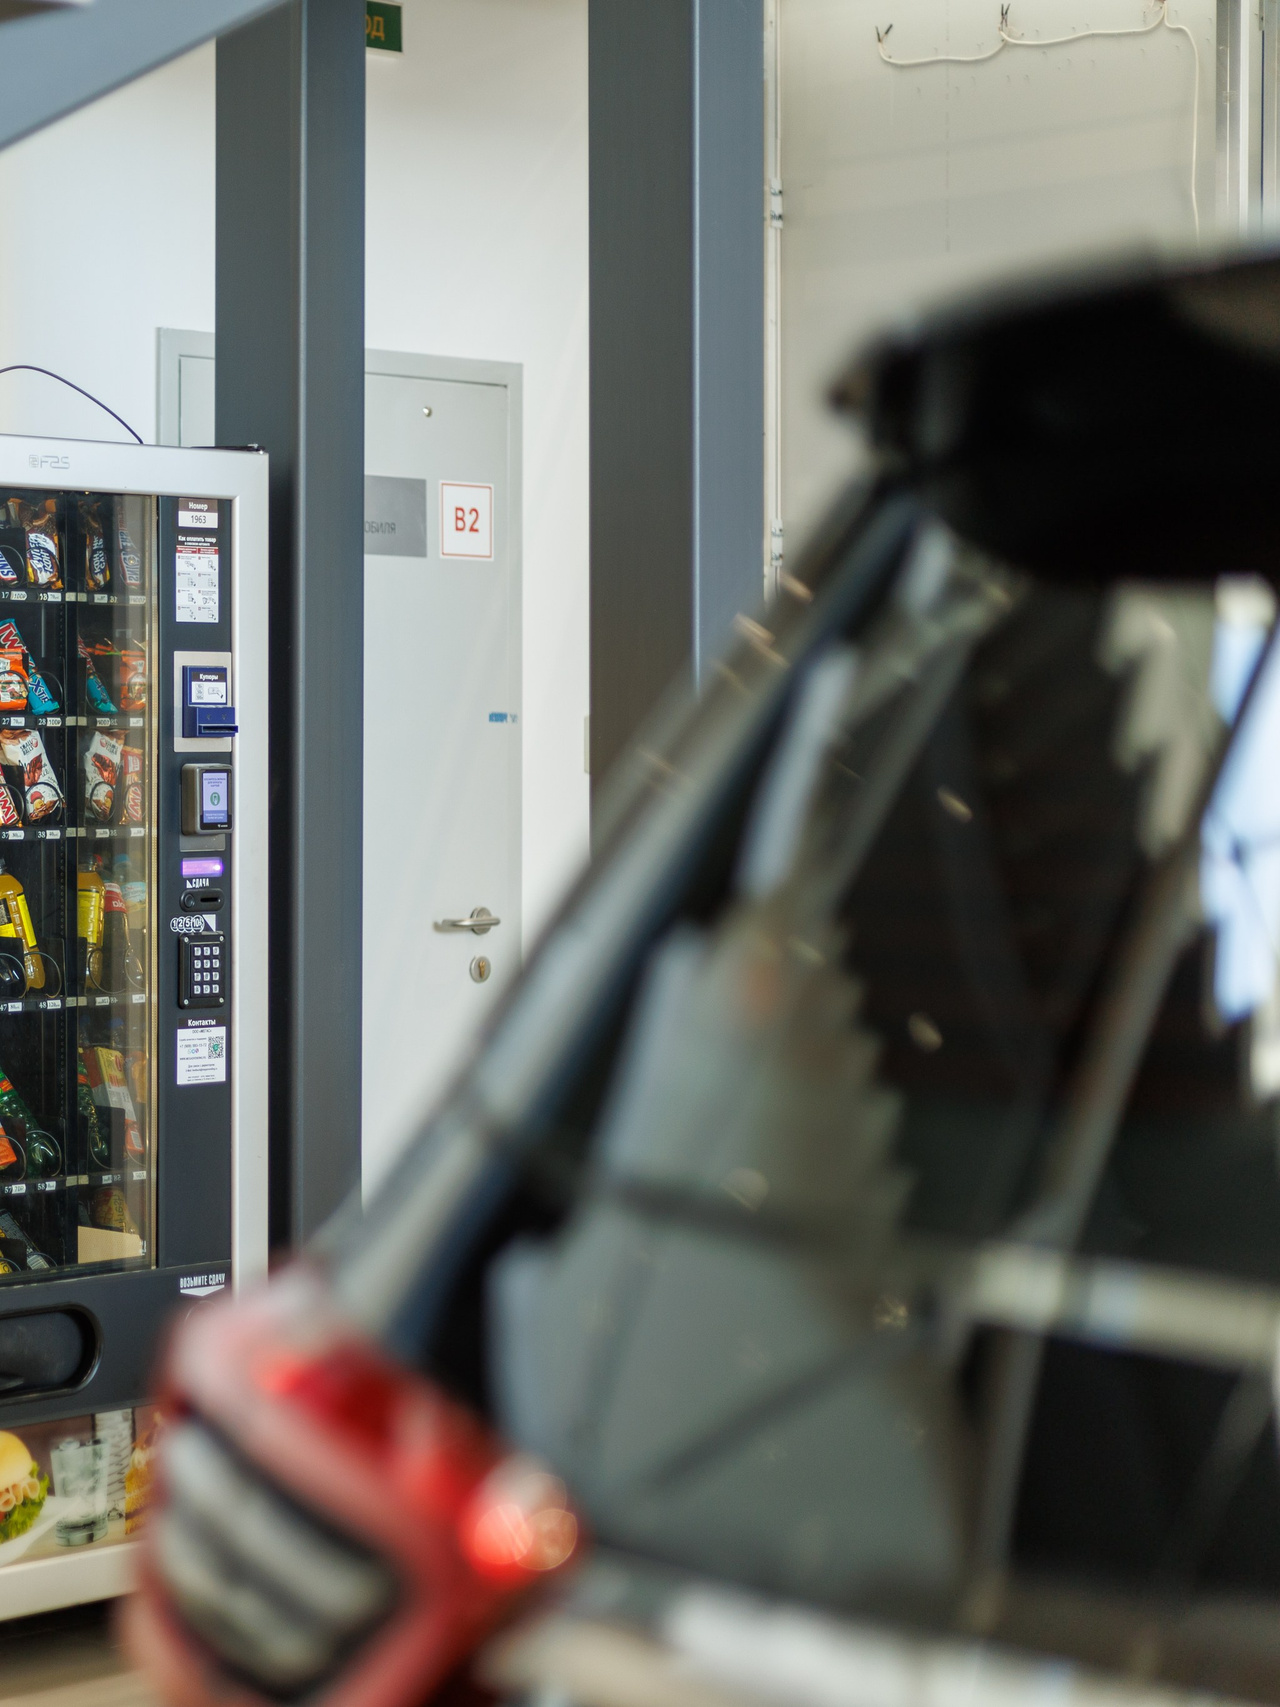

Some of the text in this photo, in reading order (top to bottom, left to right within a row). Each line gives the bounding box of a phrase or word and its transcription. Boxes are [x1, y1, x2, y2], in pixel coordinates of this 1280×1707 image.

[188, 501, 209, 511] Номер
[191, 515, 207, 524] 1963
[187, 1019, 216, 1027] Контакты
[180, 1272, 225, 1288] ВОЗЬМИТЕ СДАЧУ
